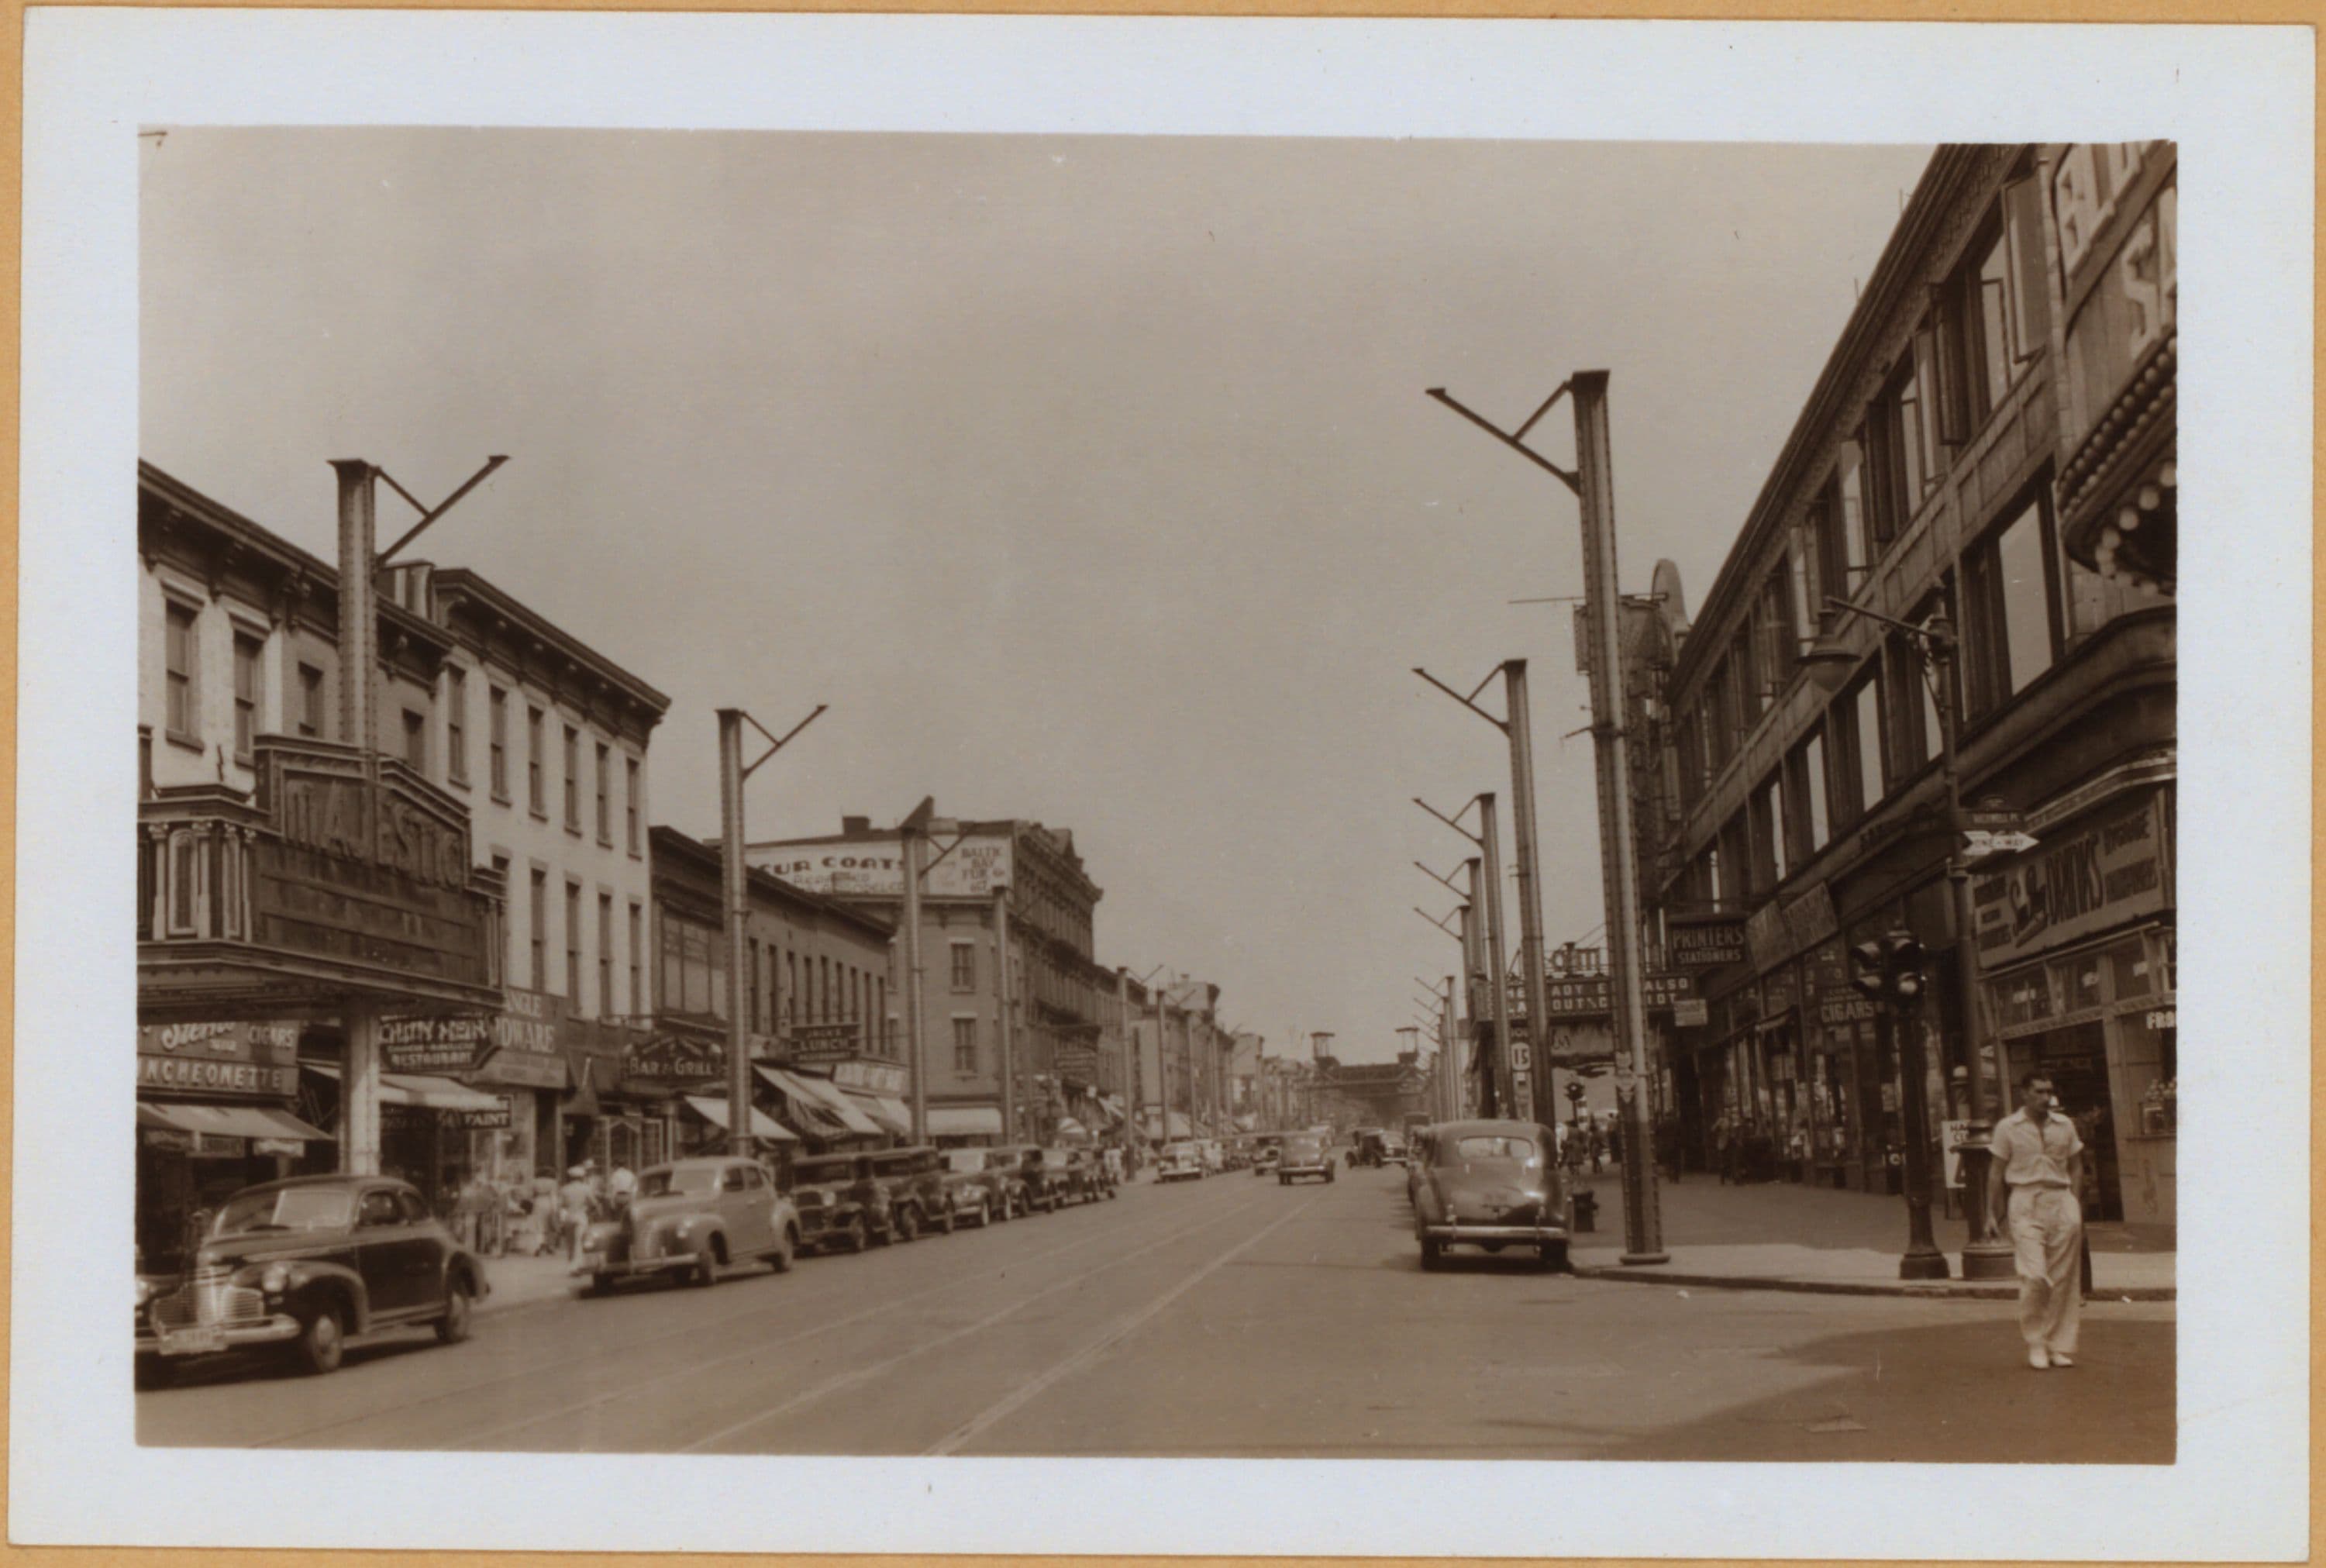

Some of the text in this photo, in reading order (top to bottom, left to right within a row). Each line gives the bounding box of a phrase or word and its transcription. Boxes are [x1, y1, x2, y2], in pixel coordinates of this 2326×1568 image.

[1673, 927, 1744, 949] PRINTERS
[1644, 977, 1688, 991] ALSO
[1821, 1001, 1874, 1023] CIGARS
[800, 1038, 849, 1052] LUNCH
[674, 1056, 713, 1076] GRILL
